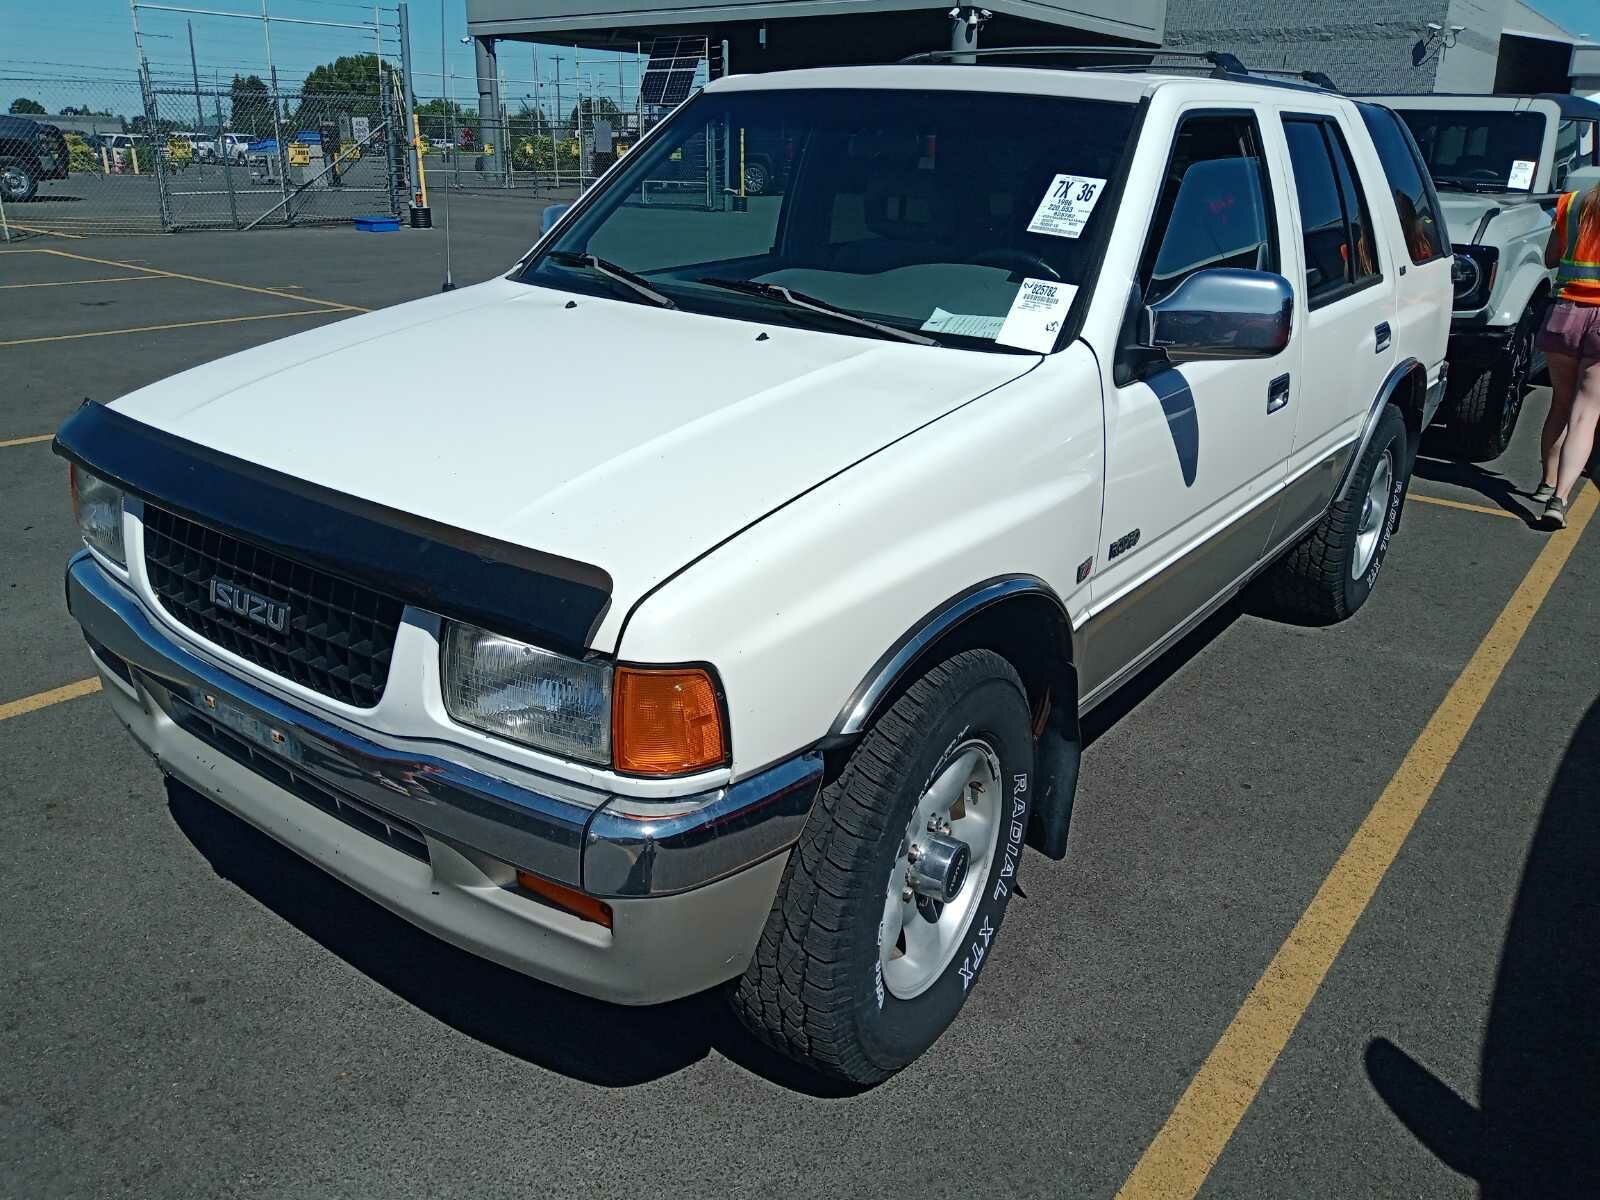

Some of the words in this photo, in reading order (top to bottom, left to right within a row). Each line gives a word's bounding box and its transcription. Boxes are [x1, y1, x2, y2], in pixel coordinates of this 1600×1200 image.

[1053, 180, 1074, 198] 7X
[1076, 183, 1097, 202] 36
[209, 578, 285, 632] ISUZU
[992, 773, 1028, 901] RADIAL
[958, 914, 994, 990] XTX
